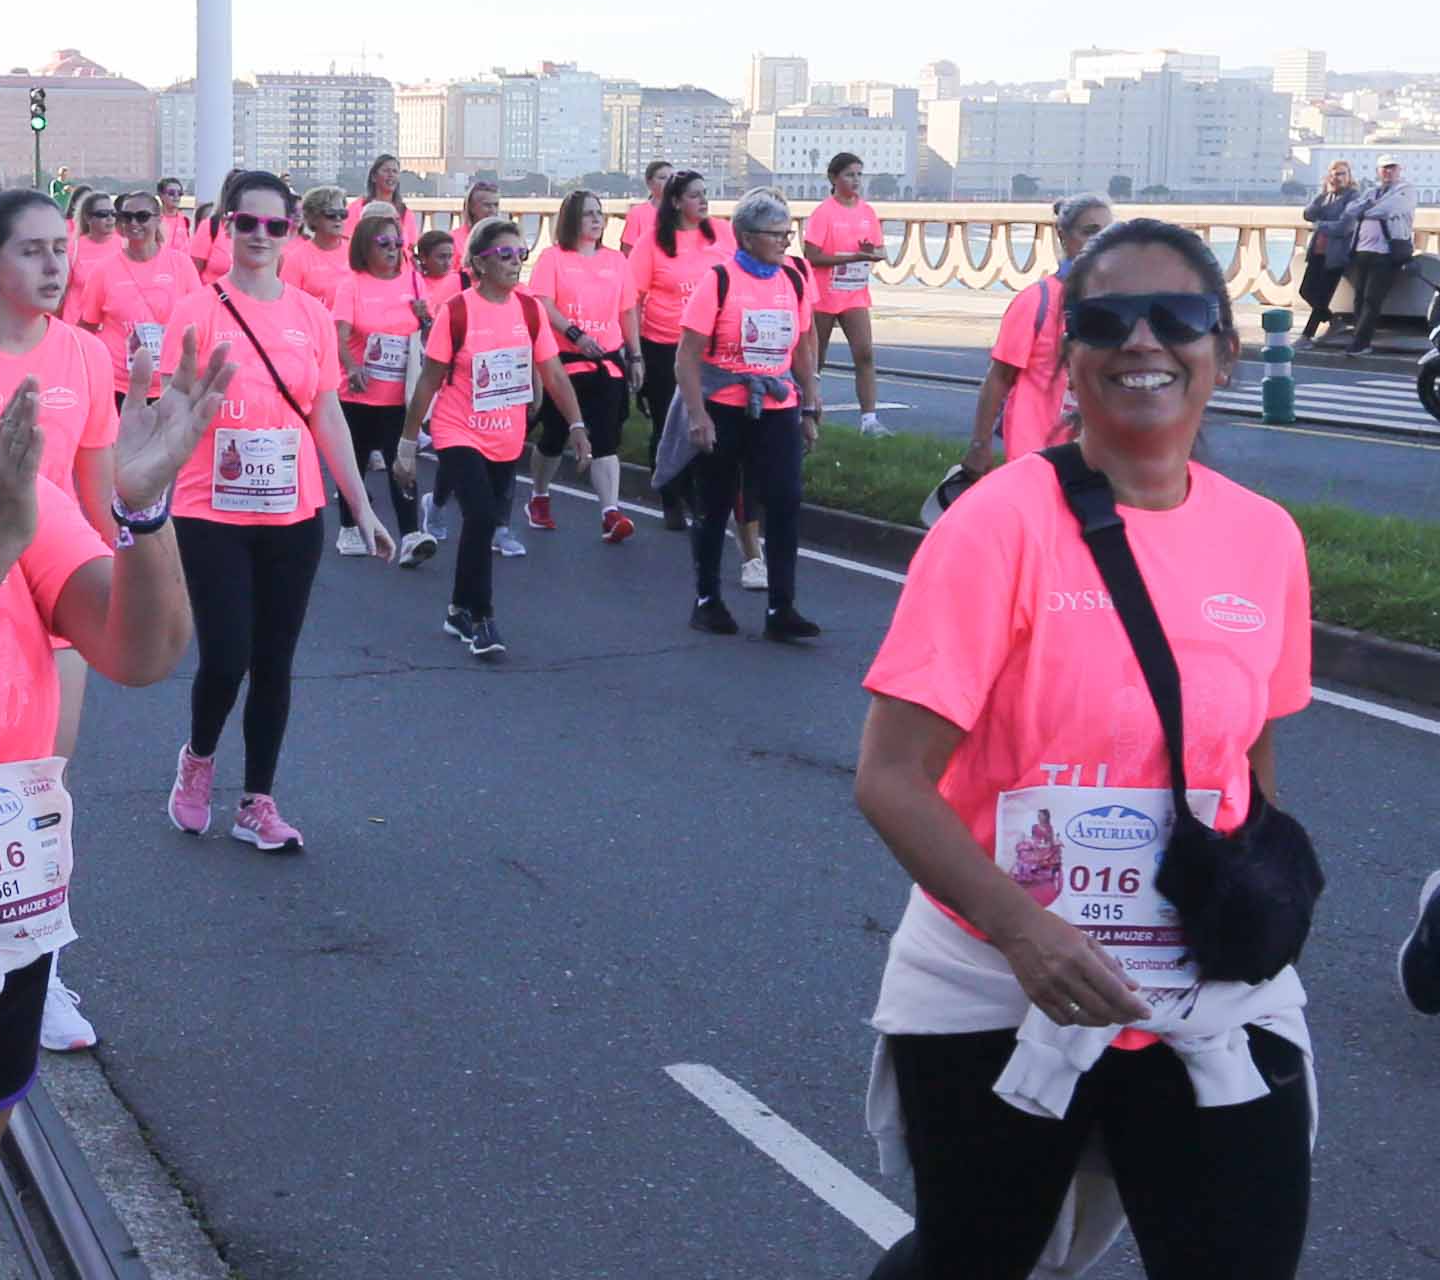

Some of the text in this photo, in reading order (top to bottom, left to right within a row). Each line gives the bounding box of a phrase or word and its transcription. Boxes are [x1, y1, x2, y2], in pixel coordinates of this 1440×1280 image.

[468, 416, 512, 429] SUMA
[245, 463, 276, 476] 016
[1073, 821, 1152, 841] ASTURIANA
[1071, 865, 1141, 894] 016
[2, 909, 17, 919] LA
[18, 900, 46, 916] MUJER
[1081, 903, 1124, 920] 4915
[1097, 931, 1113, 941] LA
[1114, 931, 1153, 942] MUJER
